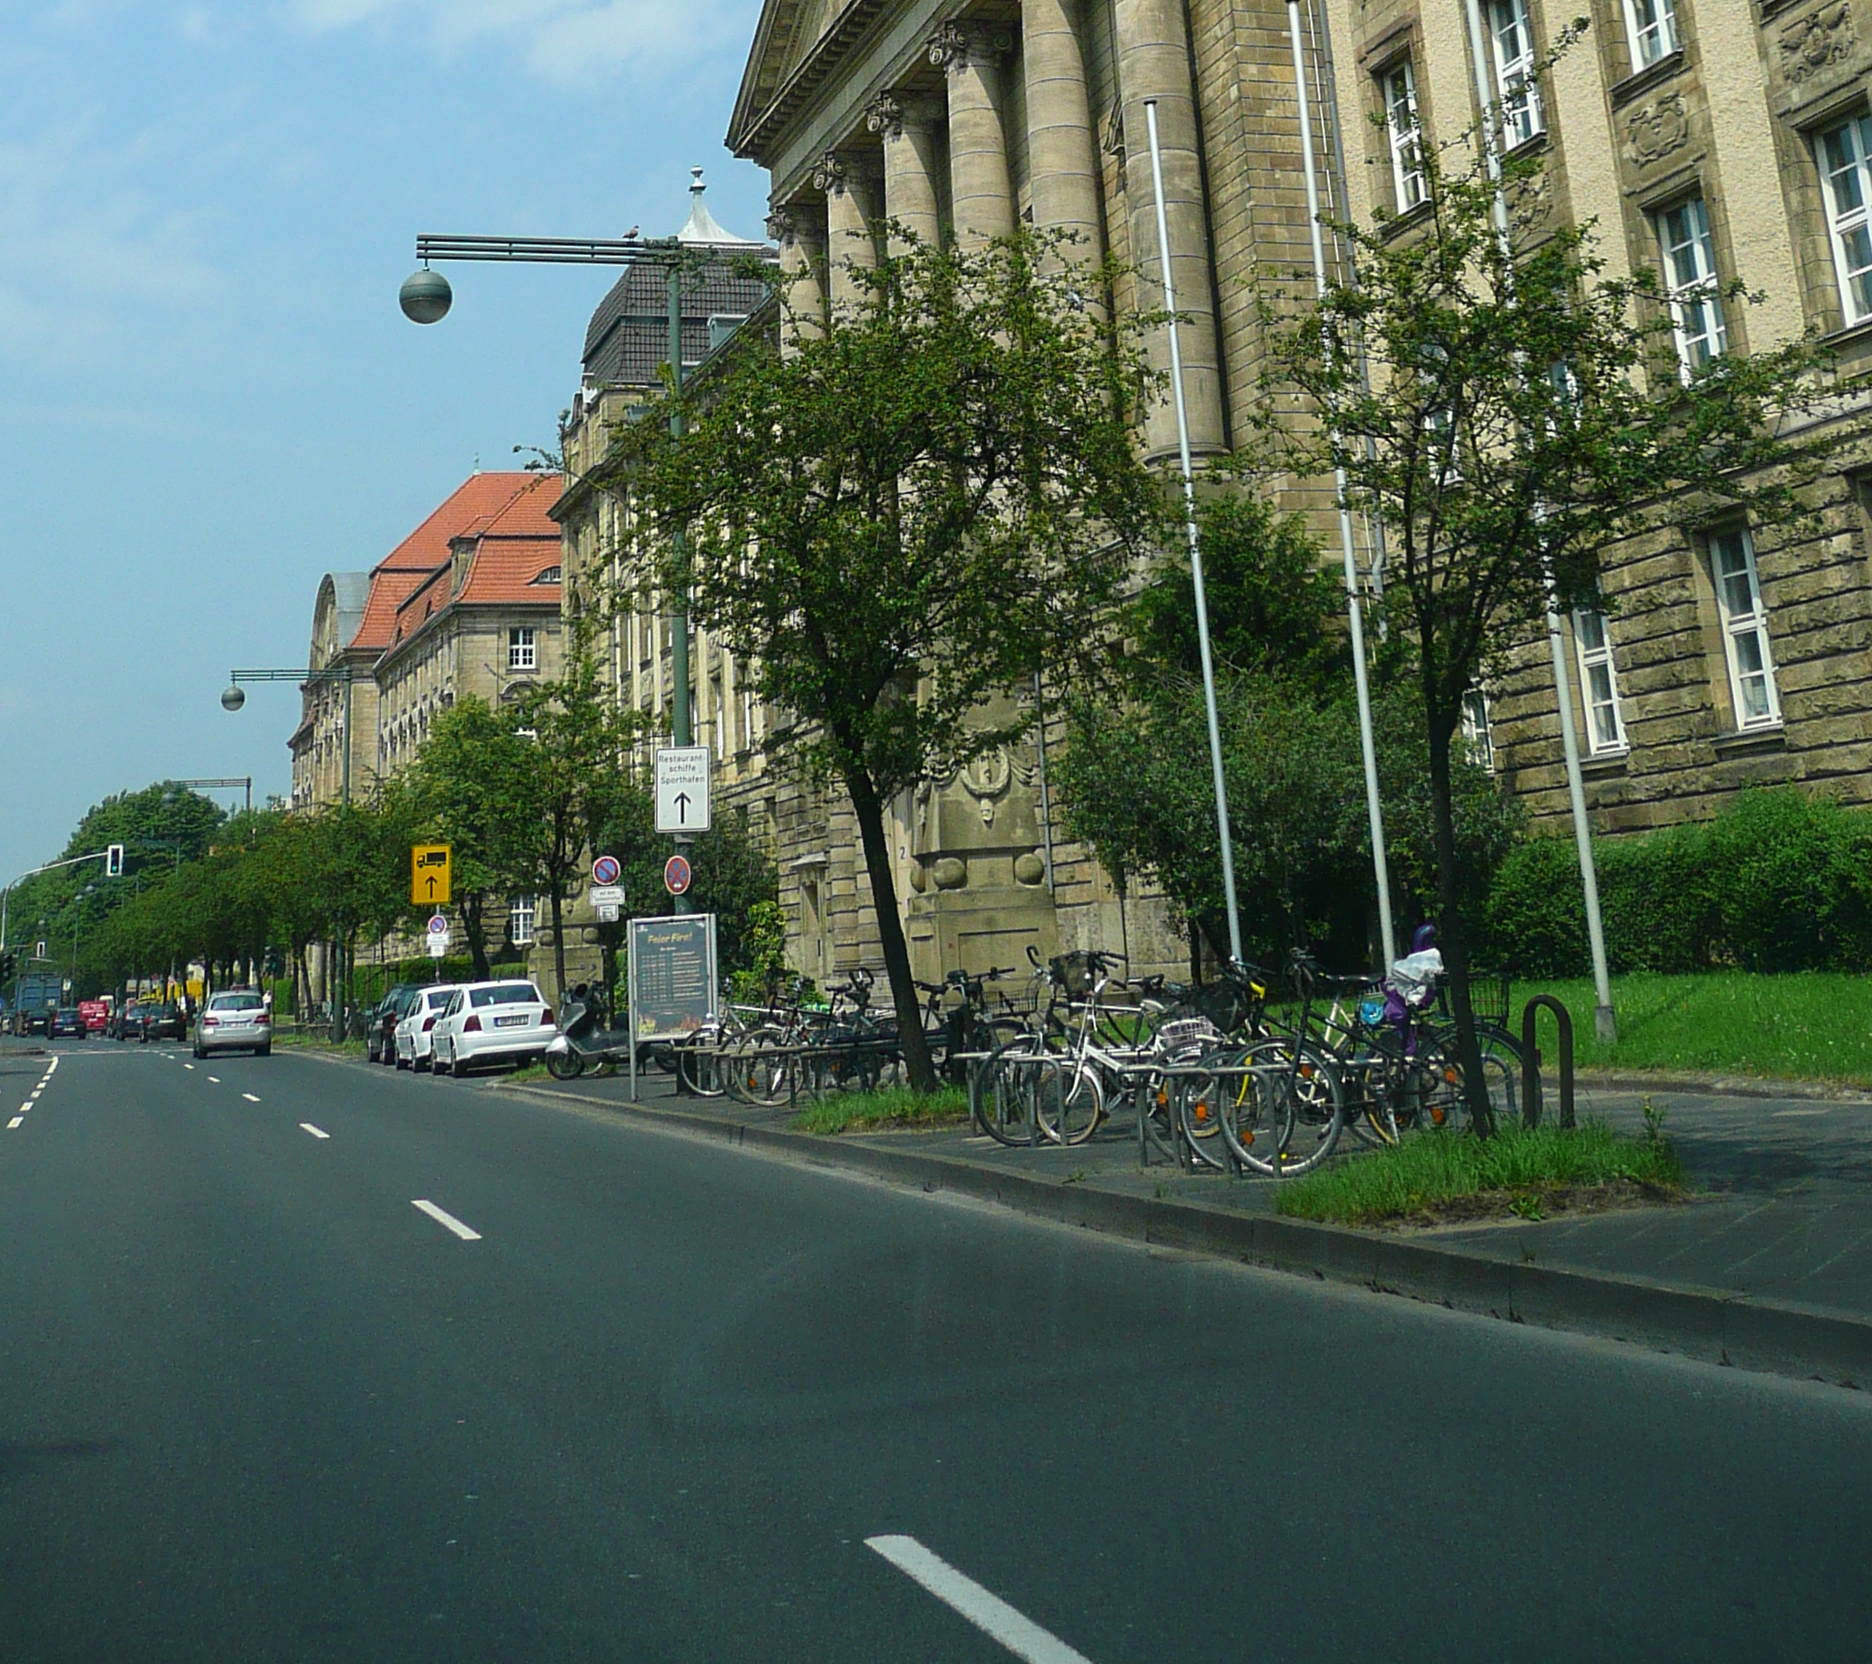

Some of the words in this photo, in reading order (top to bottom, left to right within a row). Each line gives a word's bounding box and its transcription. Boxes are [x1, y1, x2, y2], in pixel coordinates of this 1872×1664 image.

[669, 764, 696, 772] schiffe
[660, 776, 705, 785] Sporthafen
[900, 846, 906, 860] 2
